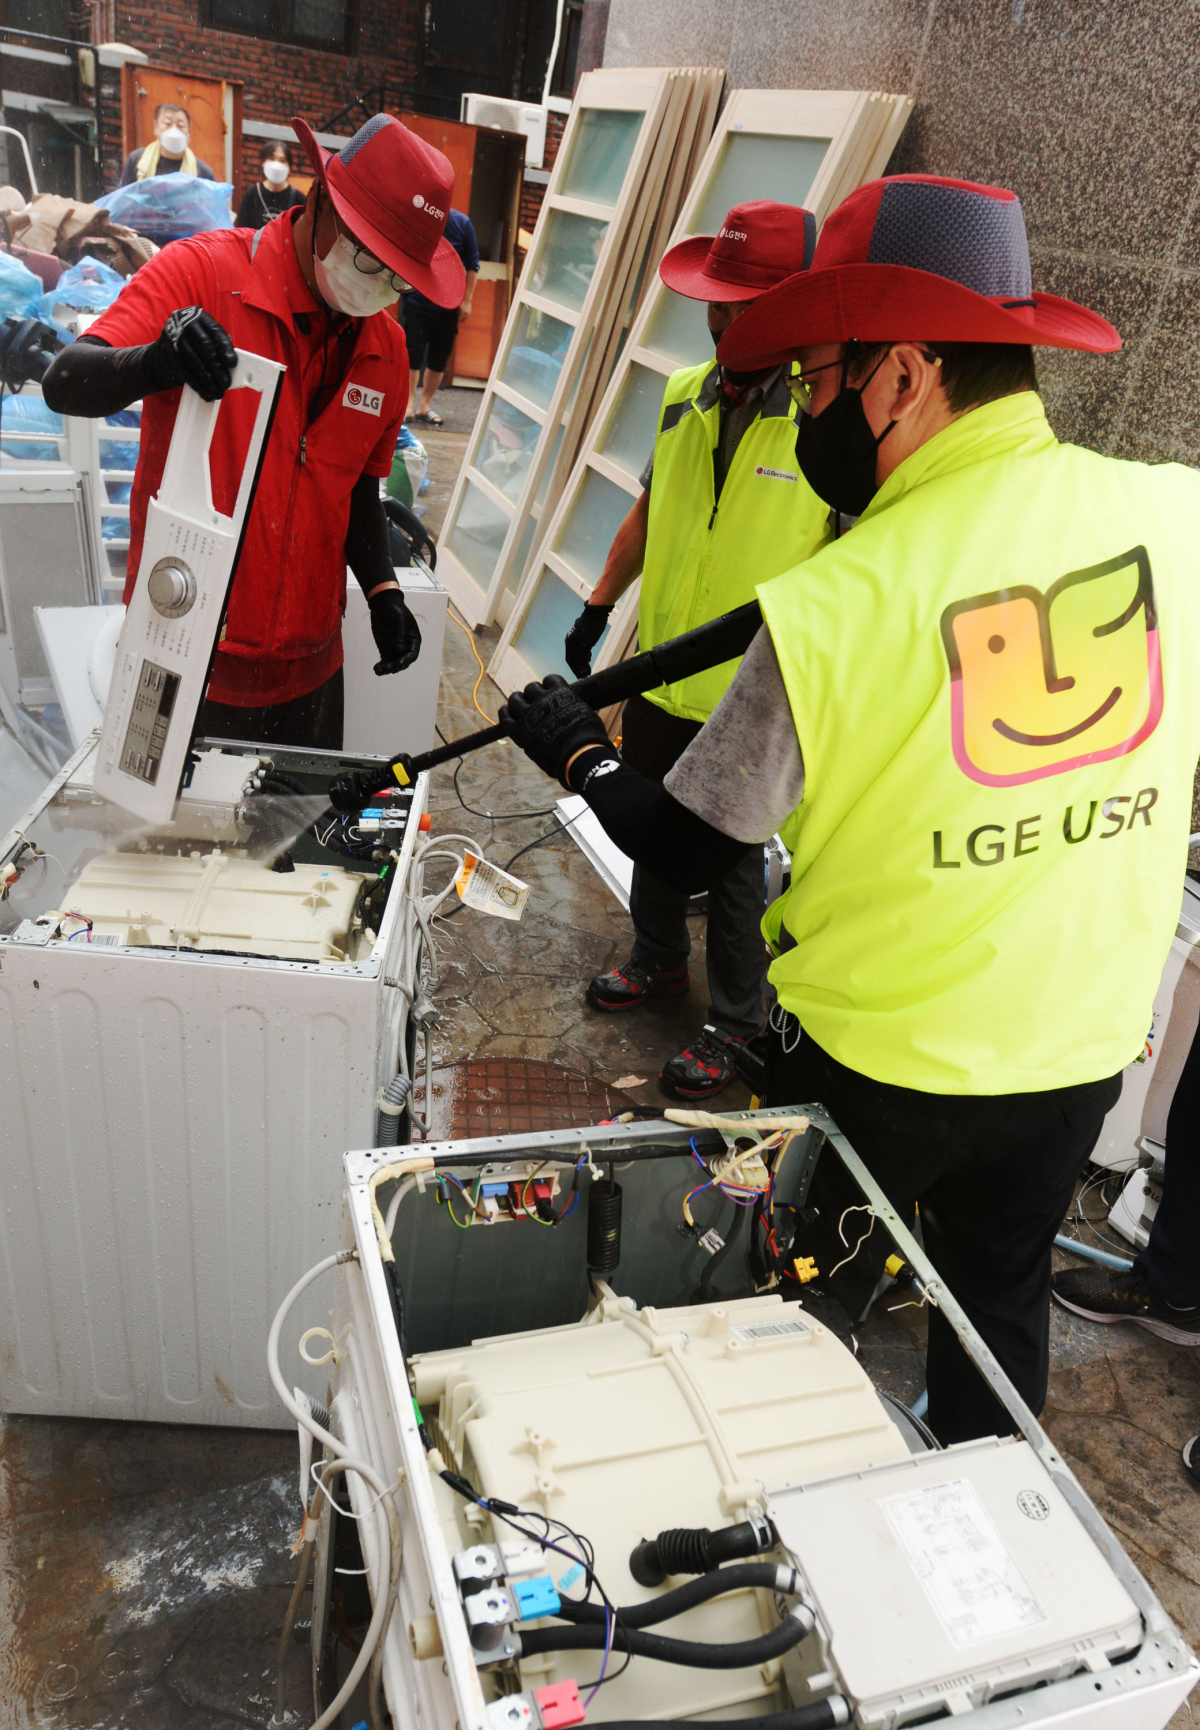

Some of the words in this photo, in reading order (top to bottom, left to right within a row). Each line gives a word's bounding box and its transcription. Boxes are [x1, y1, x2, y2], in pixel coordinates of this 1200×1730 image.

[725, 229, 748, 242] LG전자
[362, 393, 380, 410] LG
[932, 814, 1042, 869] LGE
[1062, 787, 1159, 845] USR
